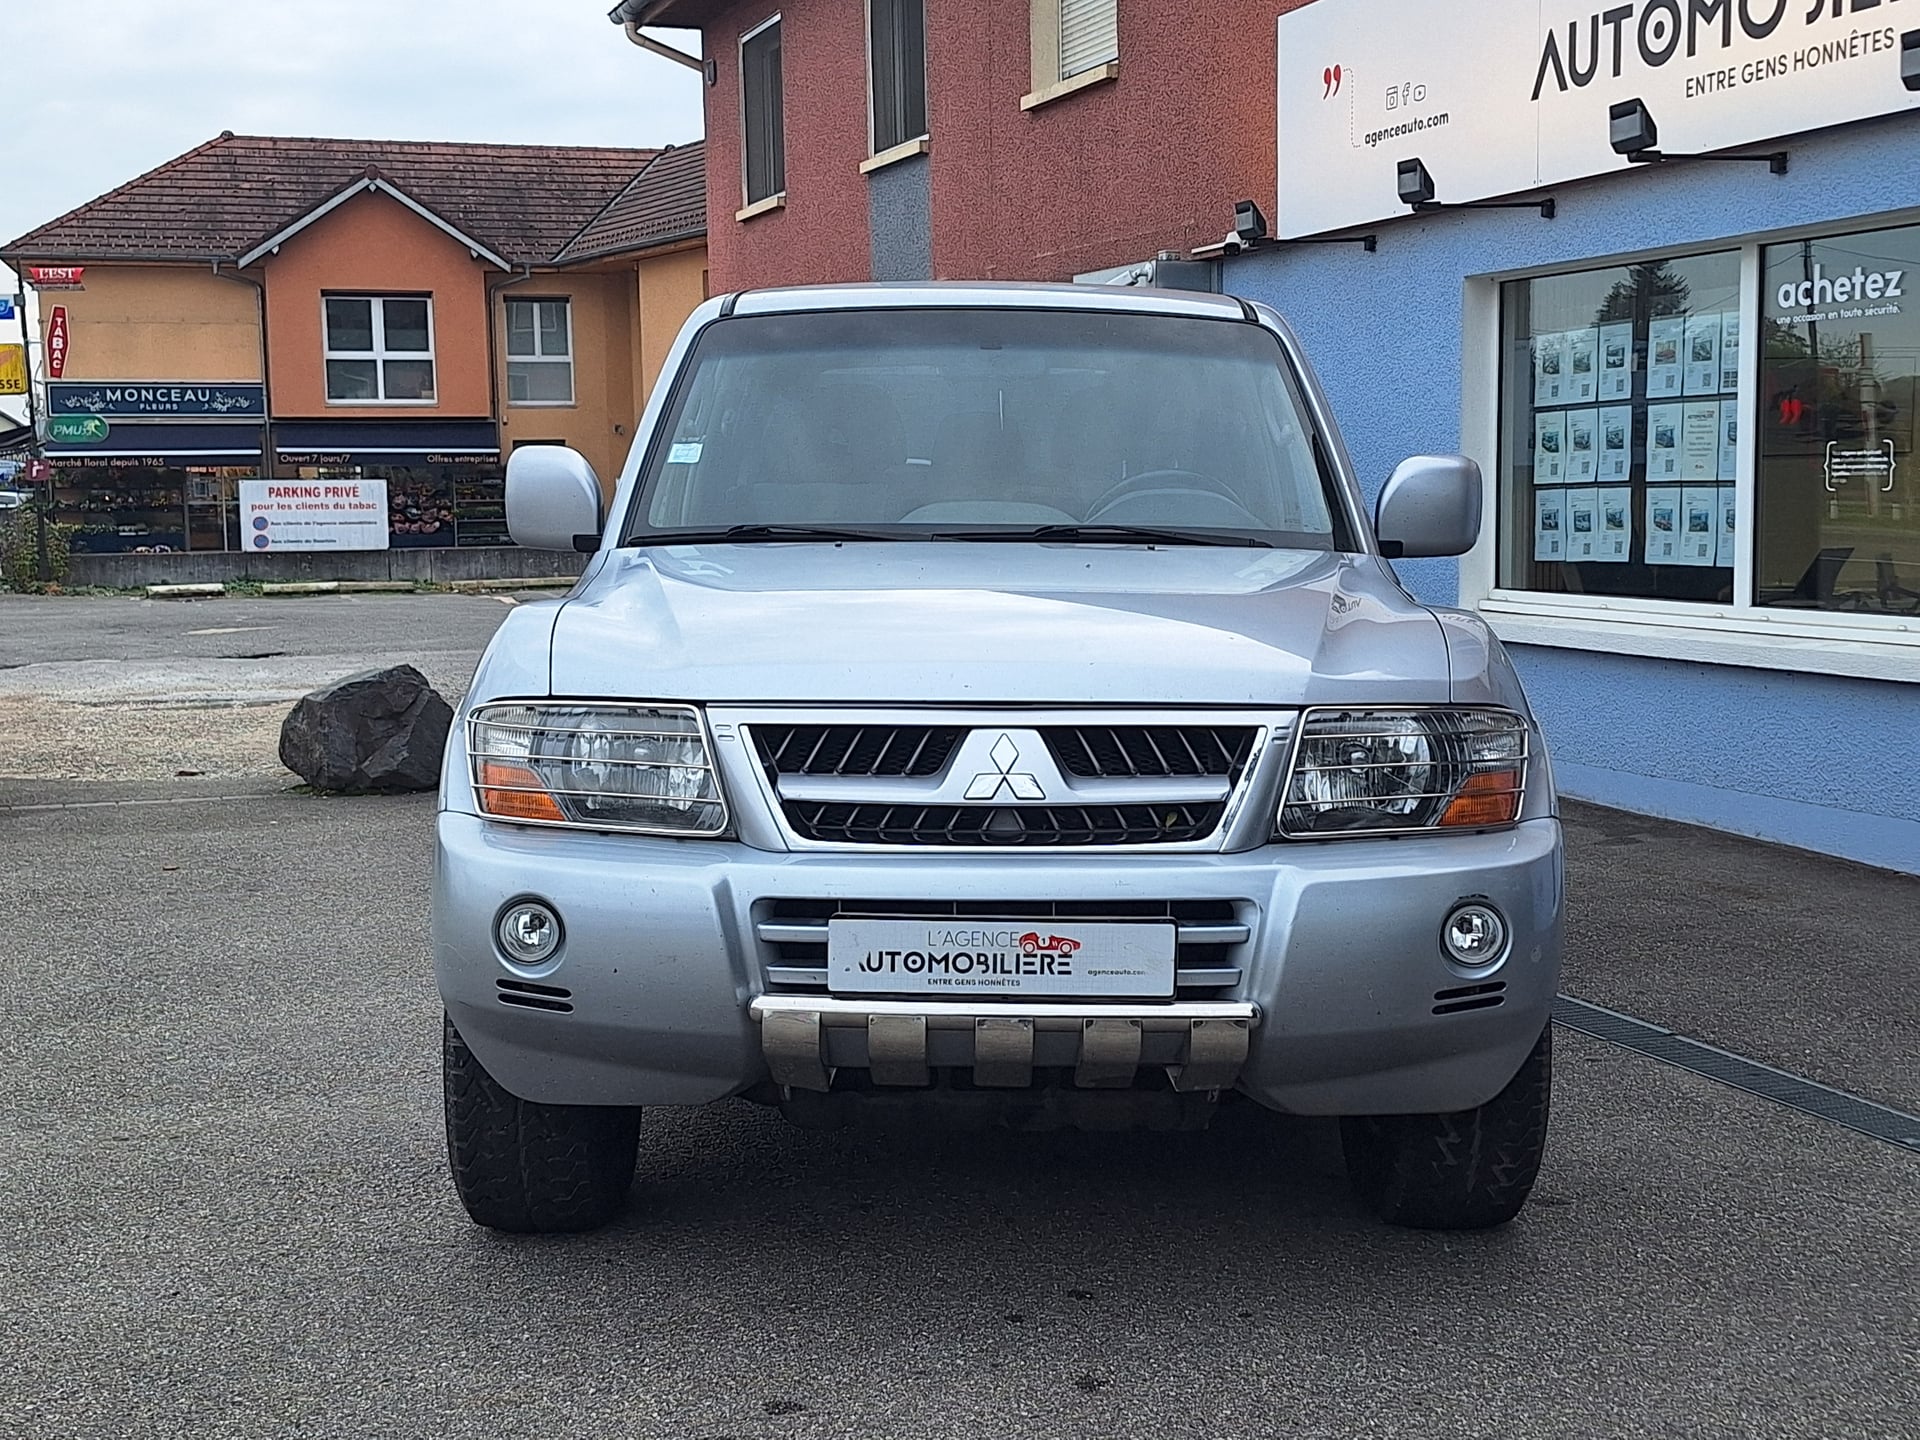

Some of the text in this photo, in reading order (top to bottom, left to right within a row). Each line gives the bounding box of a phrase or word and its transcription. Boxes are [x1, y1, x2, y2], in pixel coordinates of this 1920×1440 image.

[1531, 0, 1903, 101] AUTOMO
[1685, 27, 1895, 98] ENTRE GENS HONNÊTES
[1364, 112, 1449, 147] agenceauto.com
[1777, 263, 1903, 309] achetez
[1776, 315, 1791, 325] une
[1793, 310, 1826, 324] occasion
[1828, 311, 1838, 320] en
[1840, 307, 1862, 319] toute
[52, 317, 64, 369] TABAC
[106, 388, 210, 402] MONCEAU
[139, 403, 178, 411] FLEURS
[53, 424, 83, 436] PMU
[49, 458, 82, 467] Marché
[110, 458, 139, 468] depuis
[141, 458, 164, 467] 1965
[280, 454, 351, 465] Ouvert 7 jours/7
[427, 454, 498, 465] Offres entreprises
[268, 484, 359, 498] PARKING PRIVÉ
[251, 502, 377, 512] pour les clients du tabac
[928, 930, 1020, 948] L'AGENCE
[928, 978, 953, 986] ENTRE
[978, 977, 1020, 987] HONNÊTES
